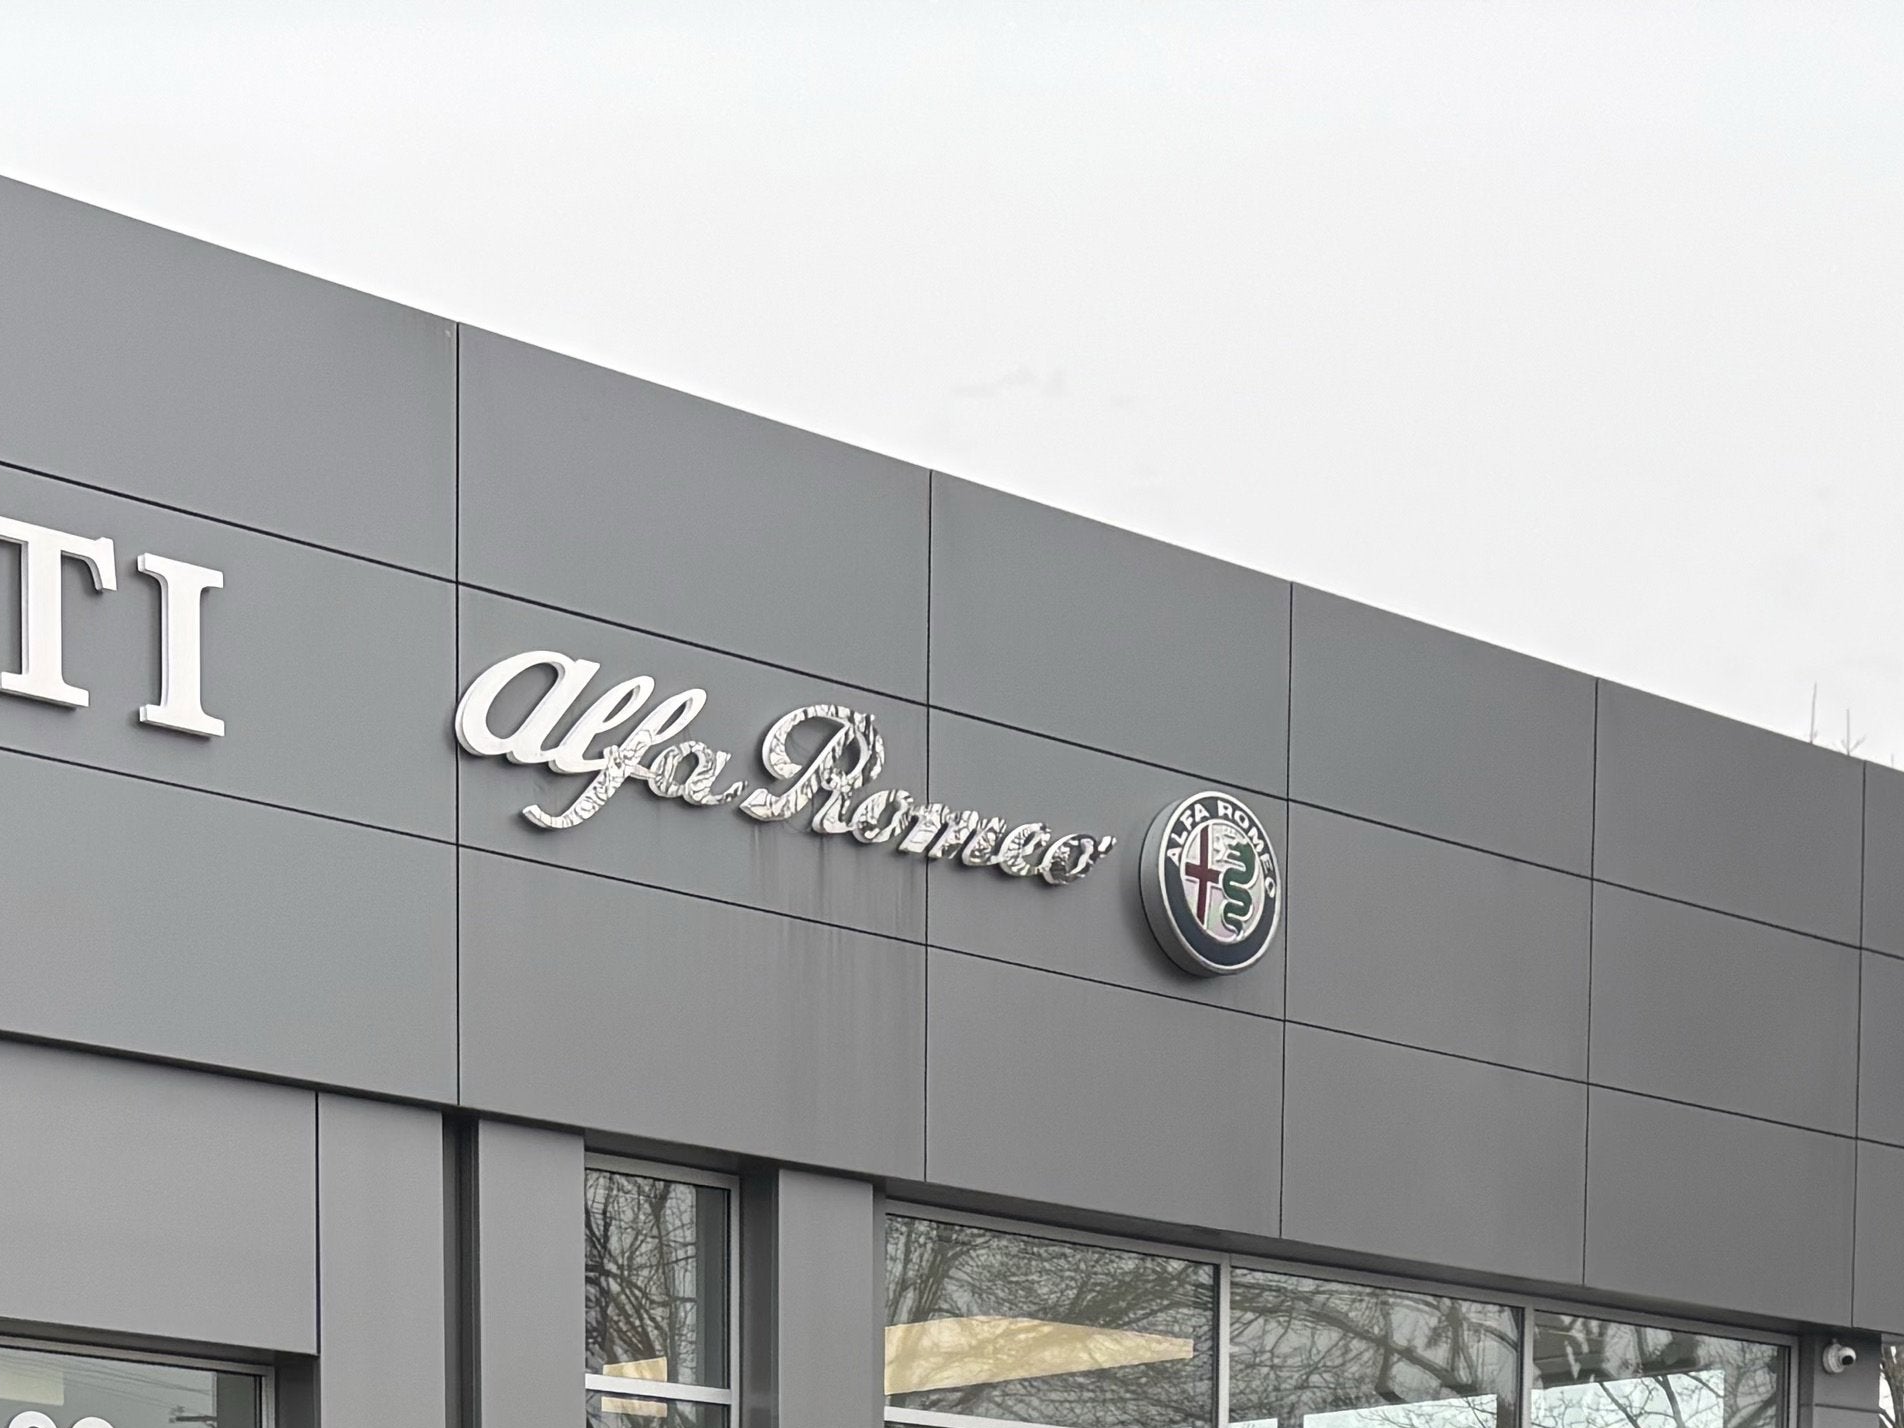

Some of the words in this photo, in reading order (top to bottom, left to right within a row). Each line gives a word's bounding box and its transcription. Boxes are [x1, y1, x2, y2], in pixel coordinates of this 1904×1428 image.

[739, 703, 1117, 885] Romeo
[1167, 803, 1210, 866] ALFA
[1217, 800, 1276, 898] ROMEO
